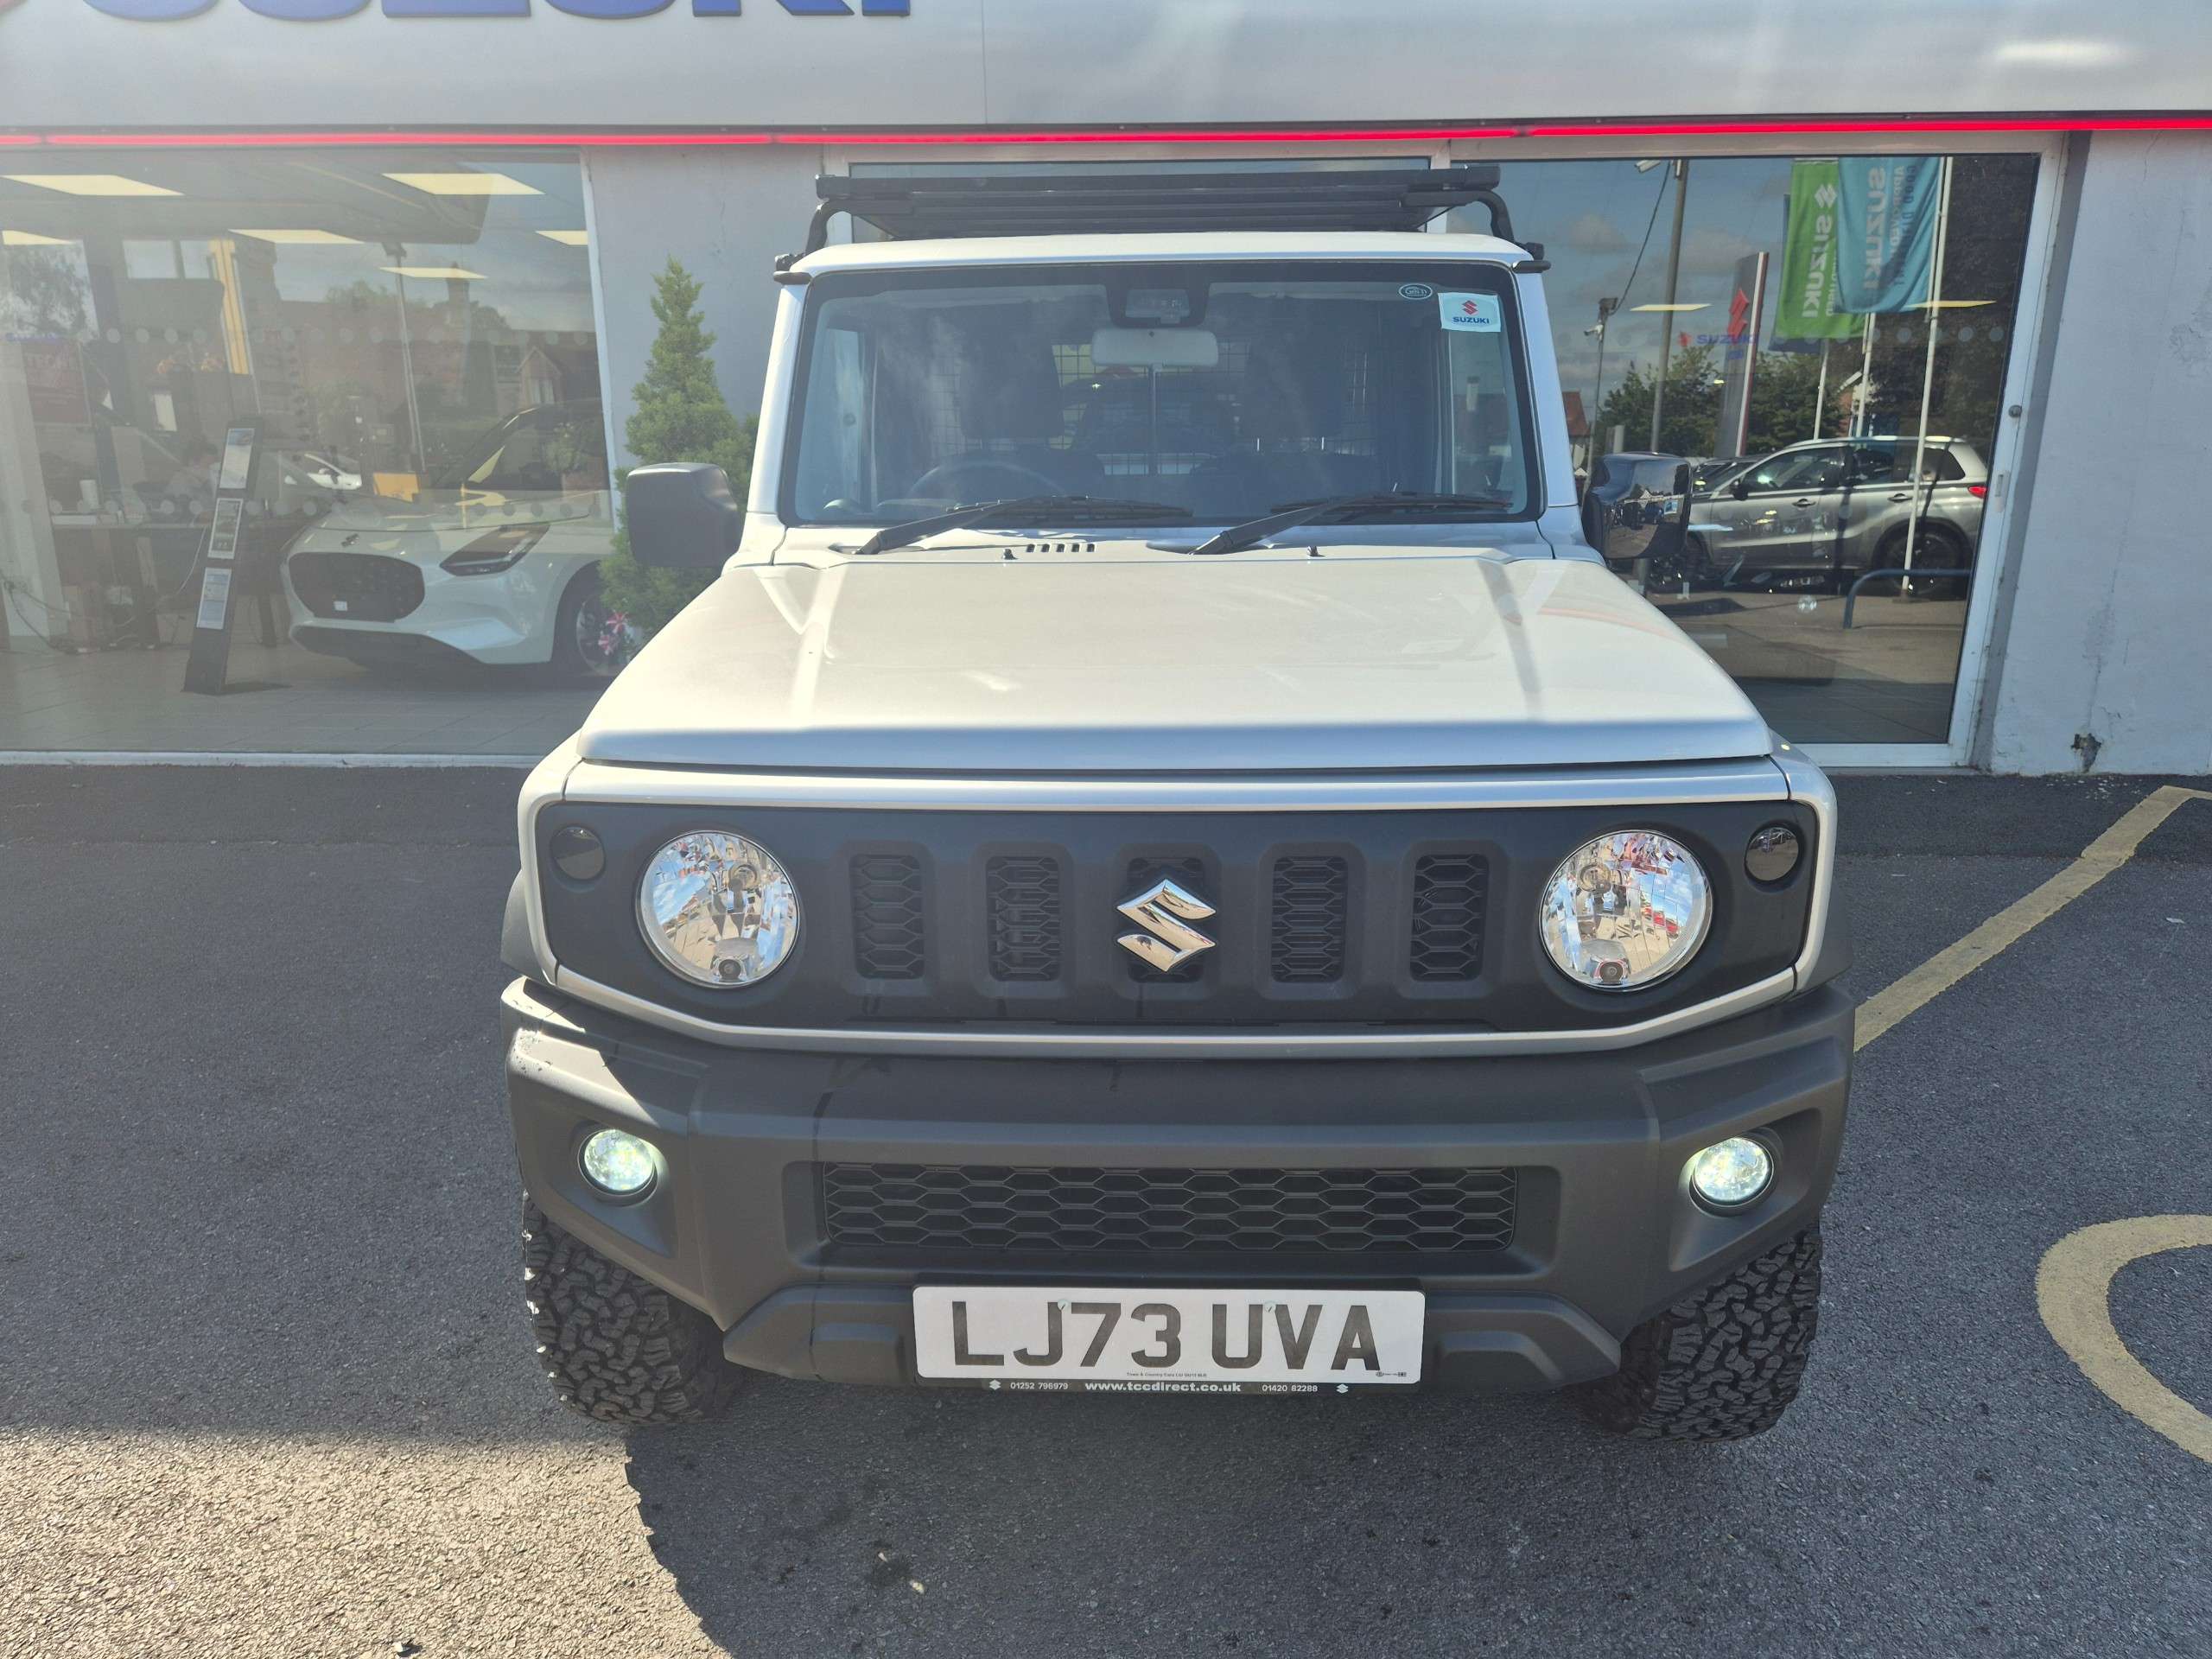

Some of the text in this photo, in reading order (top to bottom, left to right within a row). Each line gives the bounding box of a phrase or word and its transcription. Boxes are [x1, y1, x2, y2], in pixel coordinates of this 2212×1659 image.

[951, 1300, 1381, 1371] LJ73 UVA
[1084, 1382, 1242, 1392] www.tccdirect.co.uk
